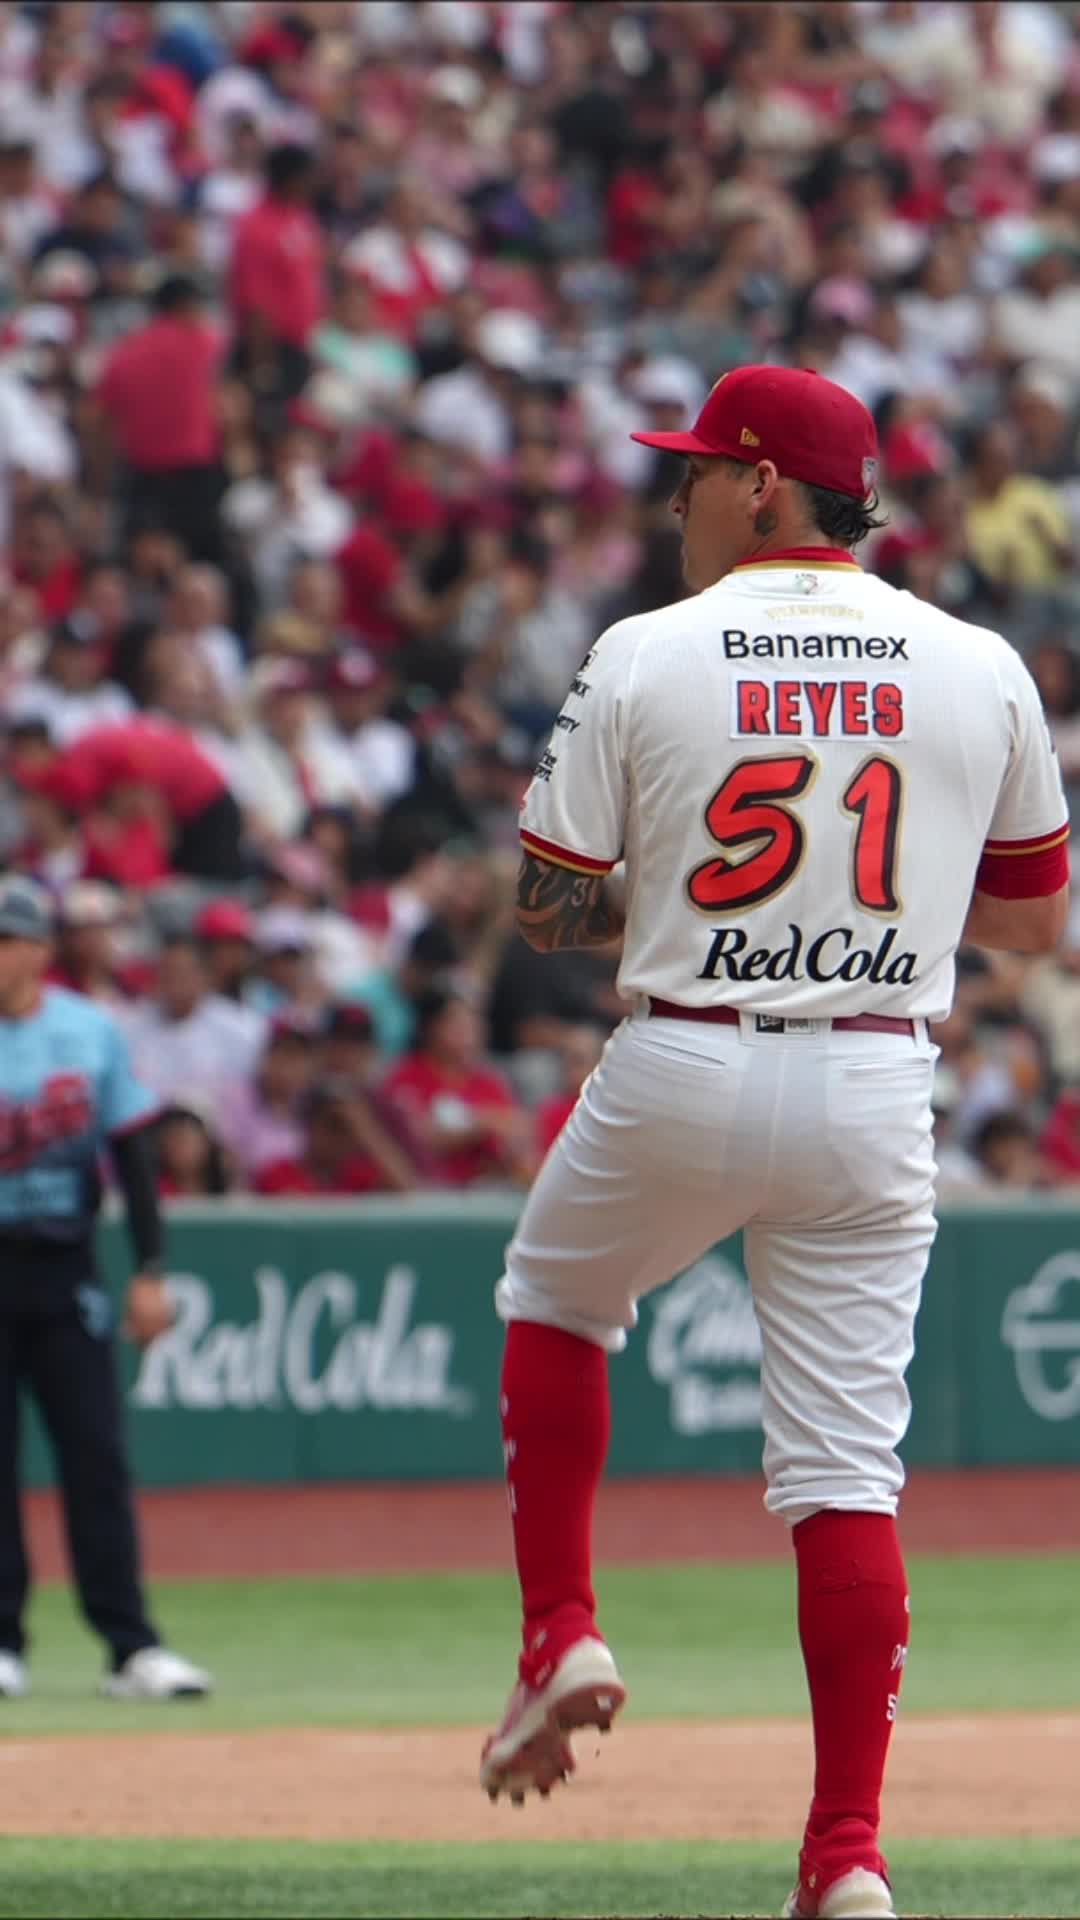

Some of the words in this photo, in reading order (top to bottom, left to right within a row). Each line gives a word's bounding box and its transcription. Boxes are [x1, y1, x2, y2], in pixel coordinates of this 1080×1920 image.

[722, 629, 909, 660] Banamex
[736, 680, 904, 737] REYES
[686, 753, 903, 917] 51
